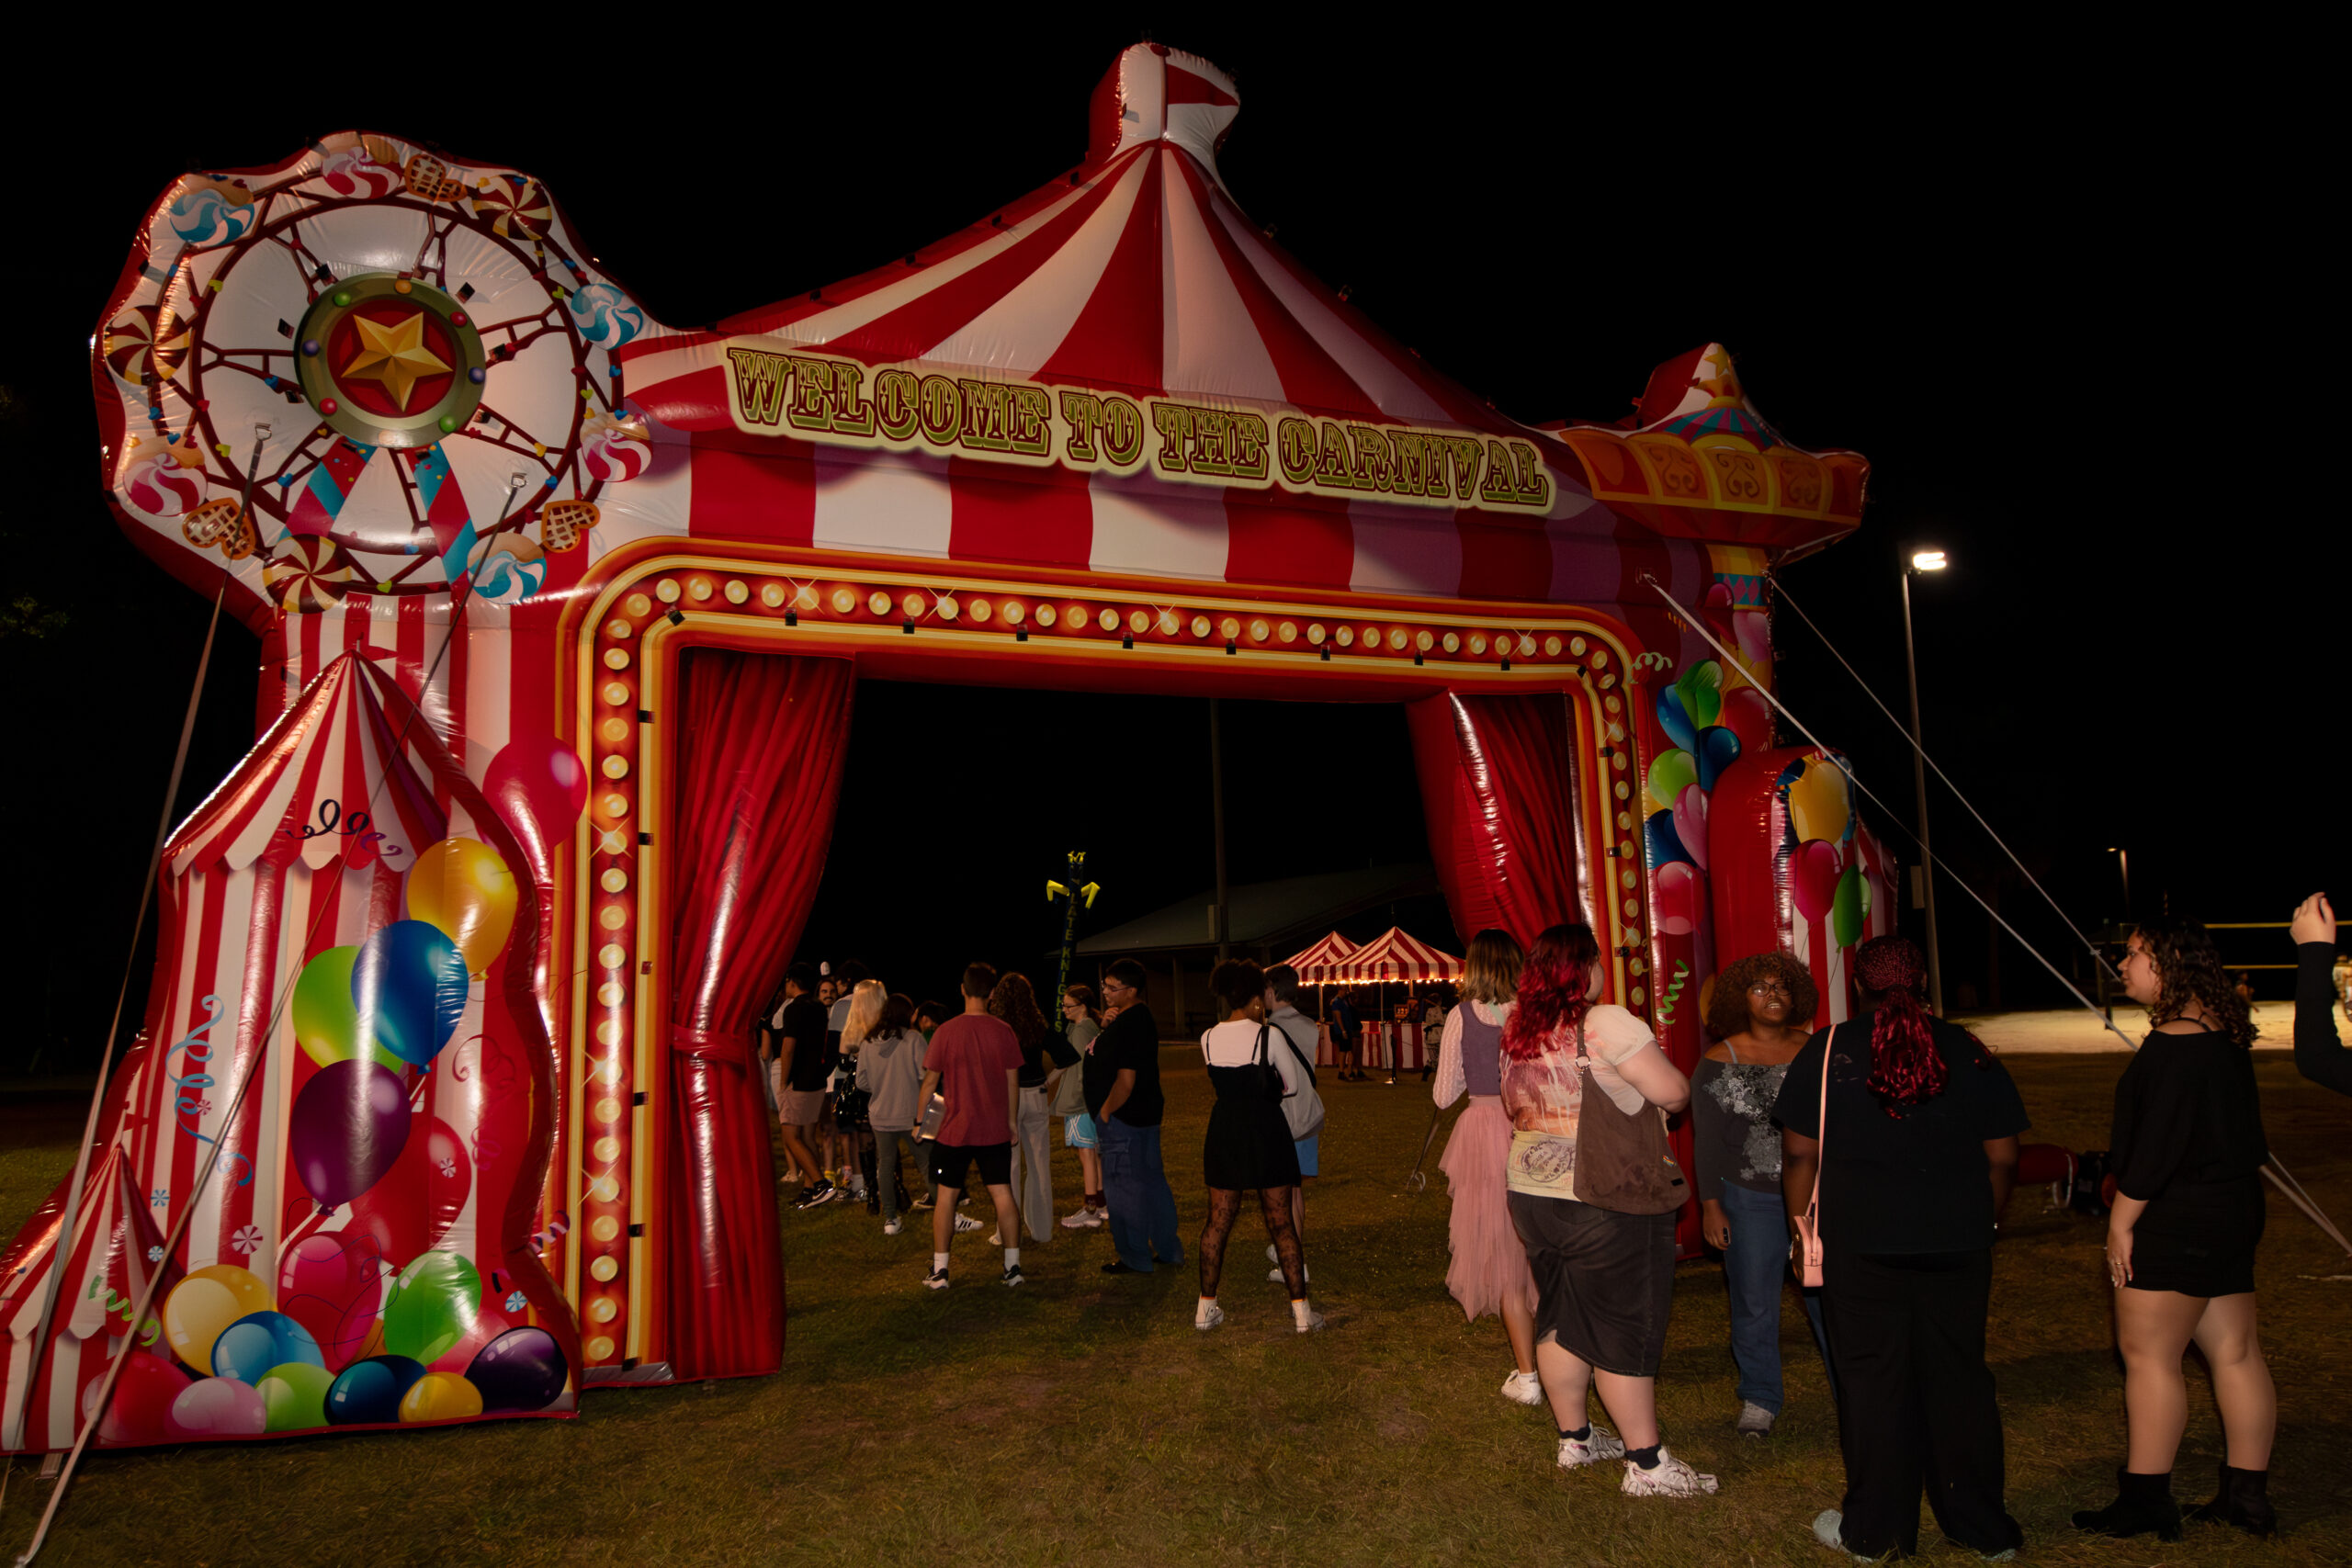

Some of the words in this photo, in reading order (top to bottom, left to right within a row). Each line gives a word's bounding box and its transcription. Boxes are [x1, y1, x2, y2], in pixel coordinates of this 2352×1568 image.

[727, 346, 1052, 457] WELCOME
[1059, 389, 1145, 467] TO
[1150, 401, 1269, 479] THE
[1277, 416, 1549, 506] CARNIVAL
[1066, 893, 1078, 941] LATE
